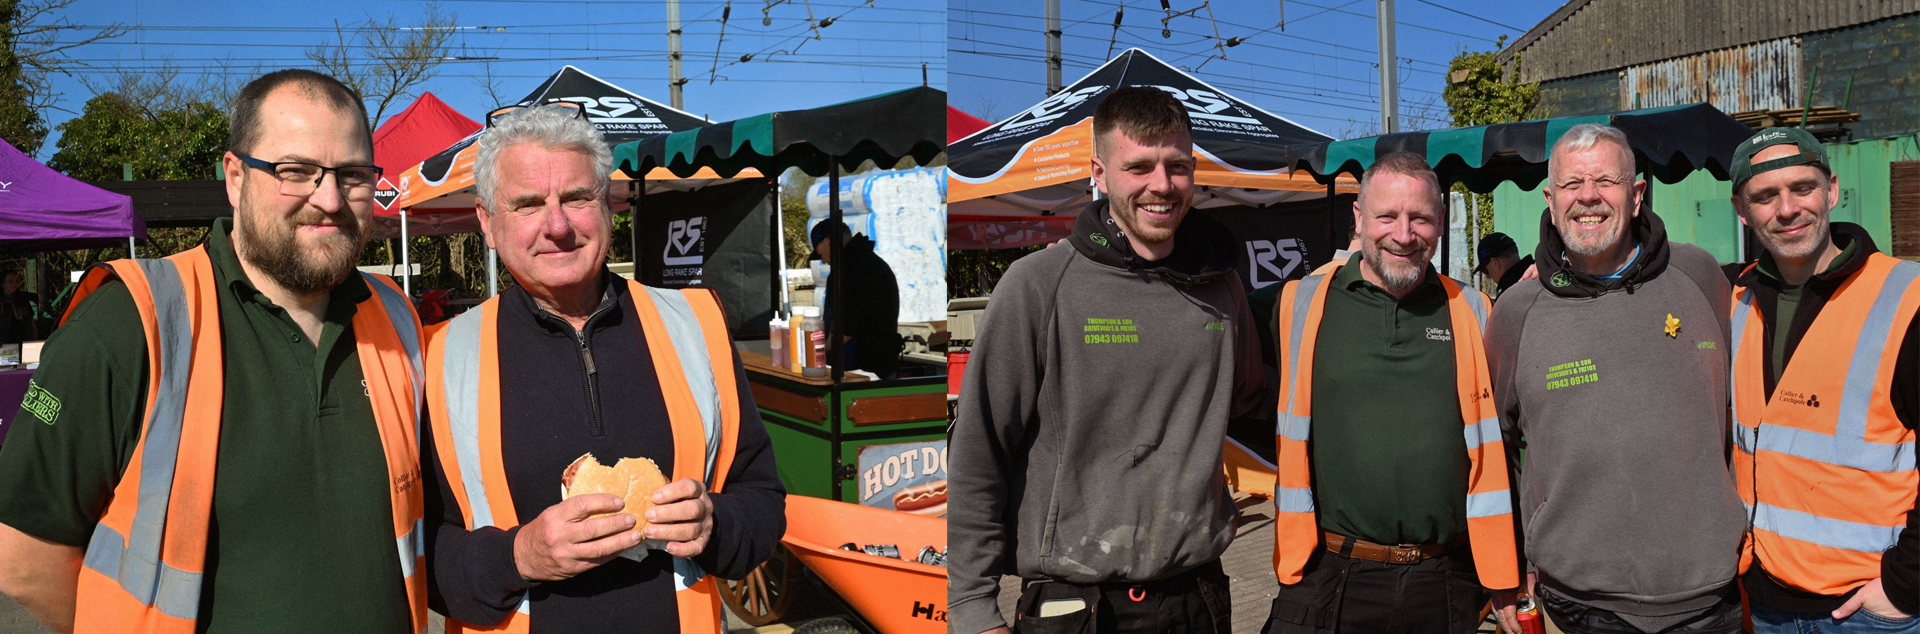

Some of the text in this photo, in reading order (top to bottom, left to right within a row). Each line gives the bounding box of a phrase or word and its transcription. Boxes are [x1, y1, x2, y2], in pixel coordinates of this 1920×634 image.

[674, 268, 688, 276] RAKE
[688, 267, 703, 276] SPAR
[1087, 317, 1117, 325] THOMPSON
[1084, 334, 1139, 344] 07943 097418
[1426, 333, 1452, 342] Catchpol
[1548, 361, 1575, 373] THOMPSON
[1580, 358, 1592, 366] SON
[1547, 372, 1599, 391] 07943 097418
[1780, 389, 1798, 398] Collier
[38, 391, 59, 411] WITH
[1778, 395, 1806, 405] Catchpole
[863, 448, 919, 501] HOT
